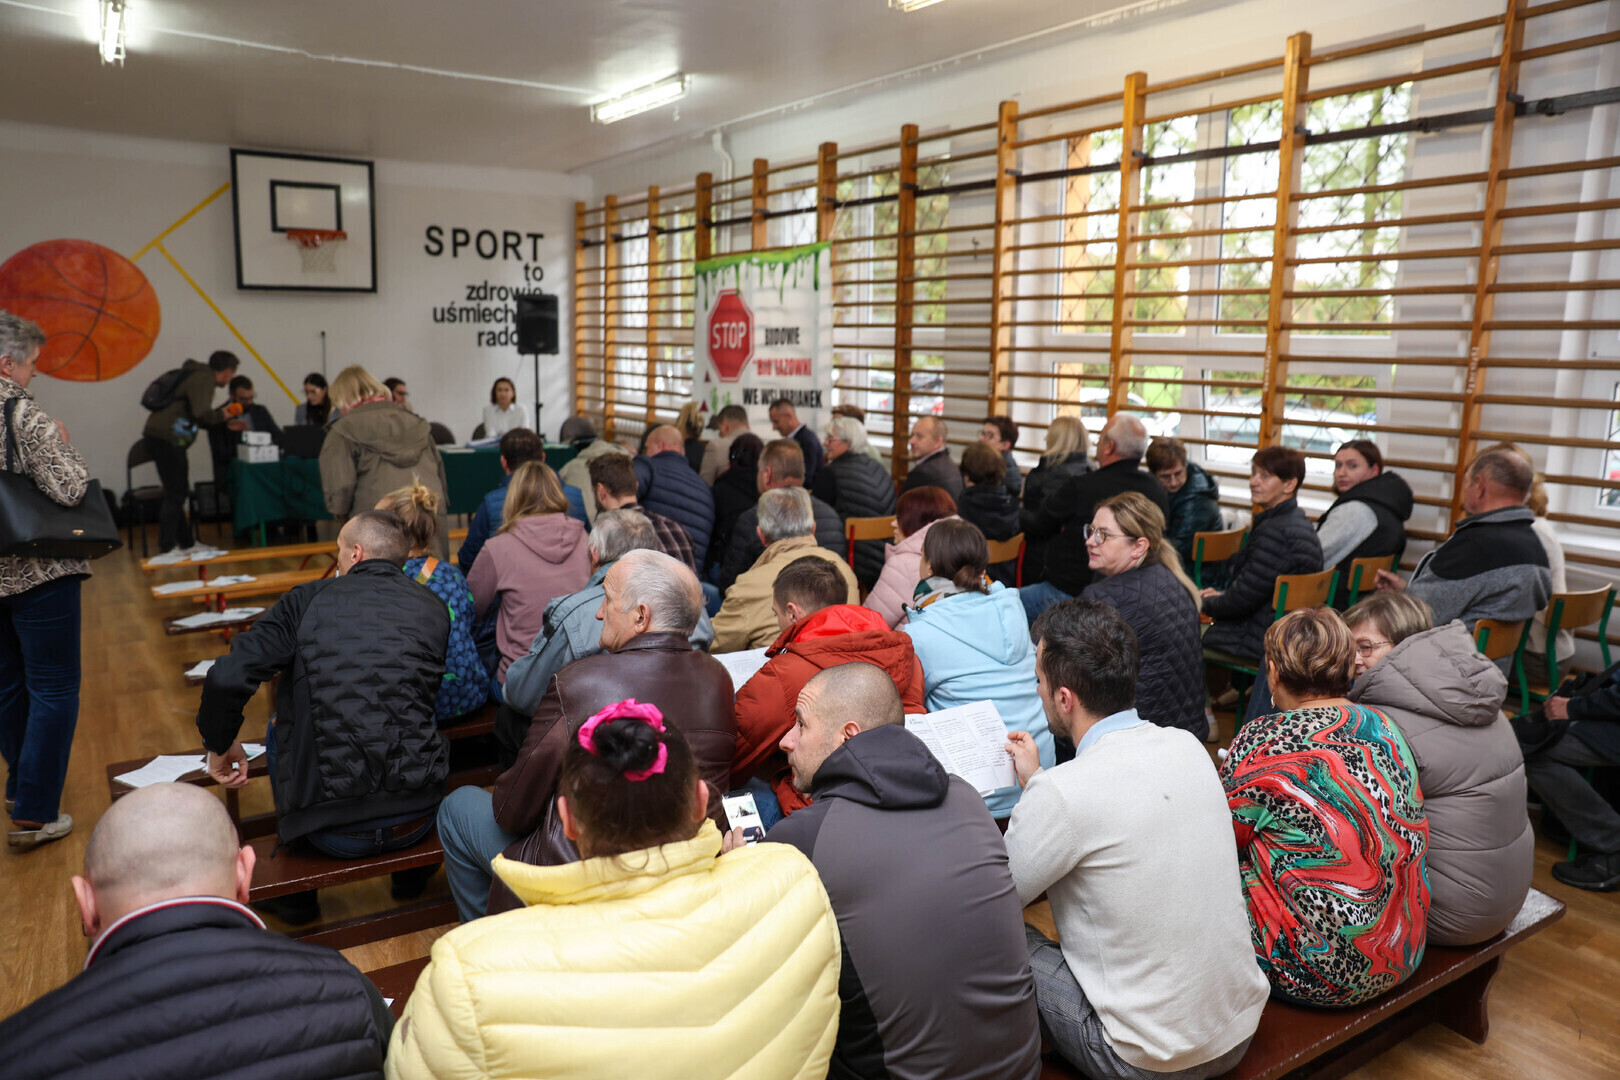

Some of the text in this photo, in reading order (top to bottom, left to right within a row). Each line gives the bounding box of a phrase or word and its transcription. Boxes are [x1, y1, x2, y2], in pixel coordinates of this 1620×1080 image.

[424, 225, 544, 262] SPORT
[523, 263, 544, 282] to
[477, 326, 519, 347] rado
[712, 321, 747, 350] STOP
[743, 387, 759, 405] WE
